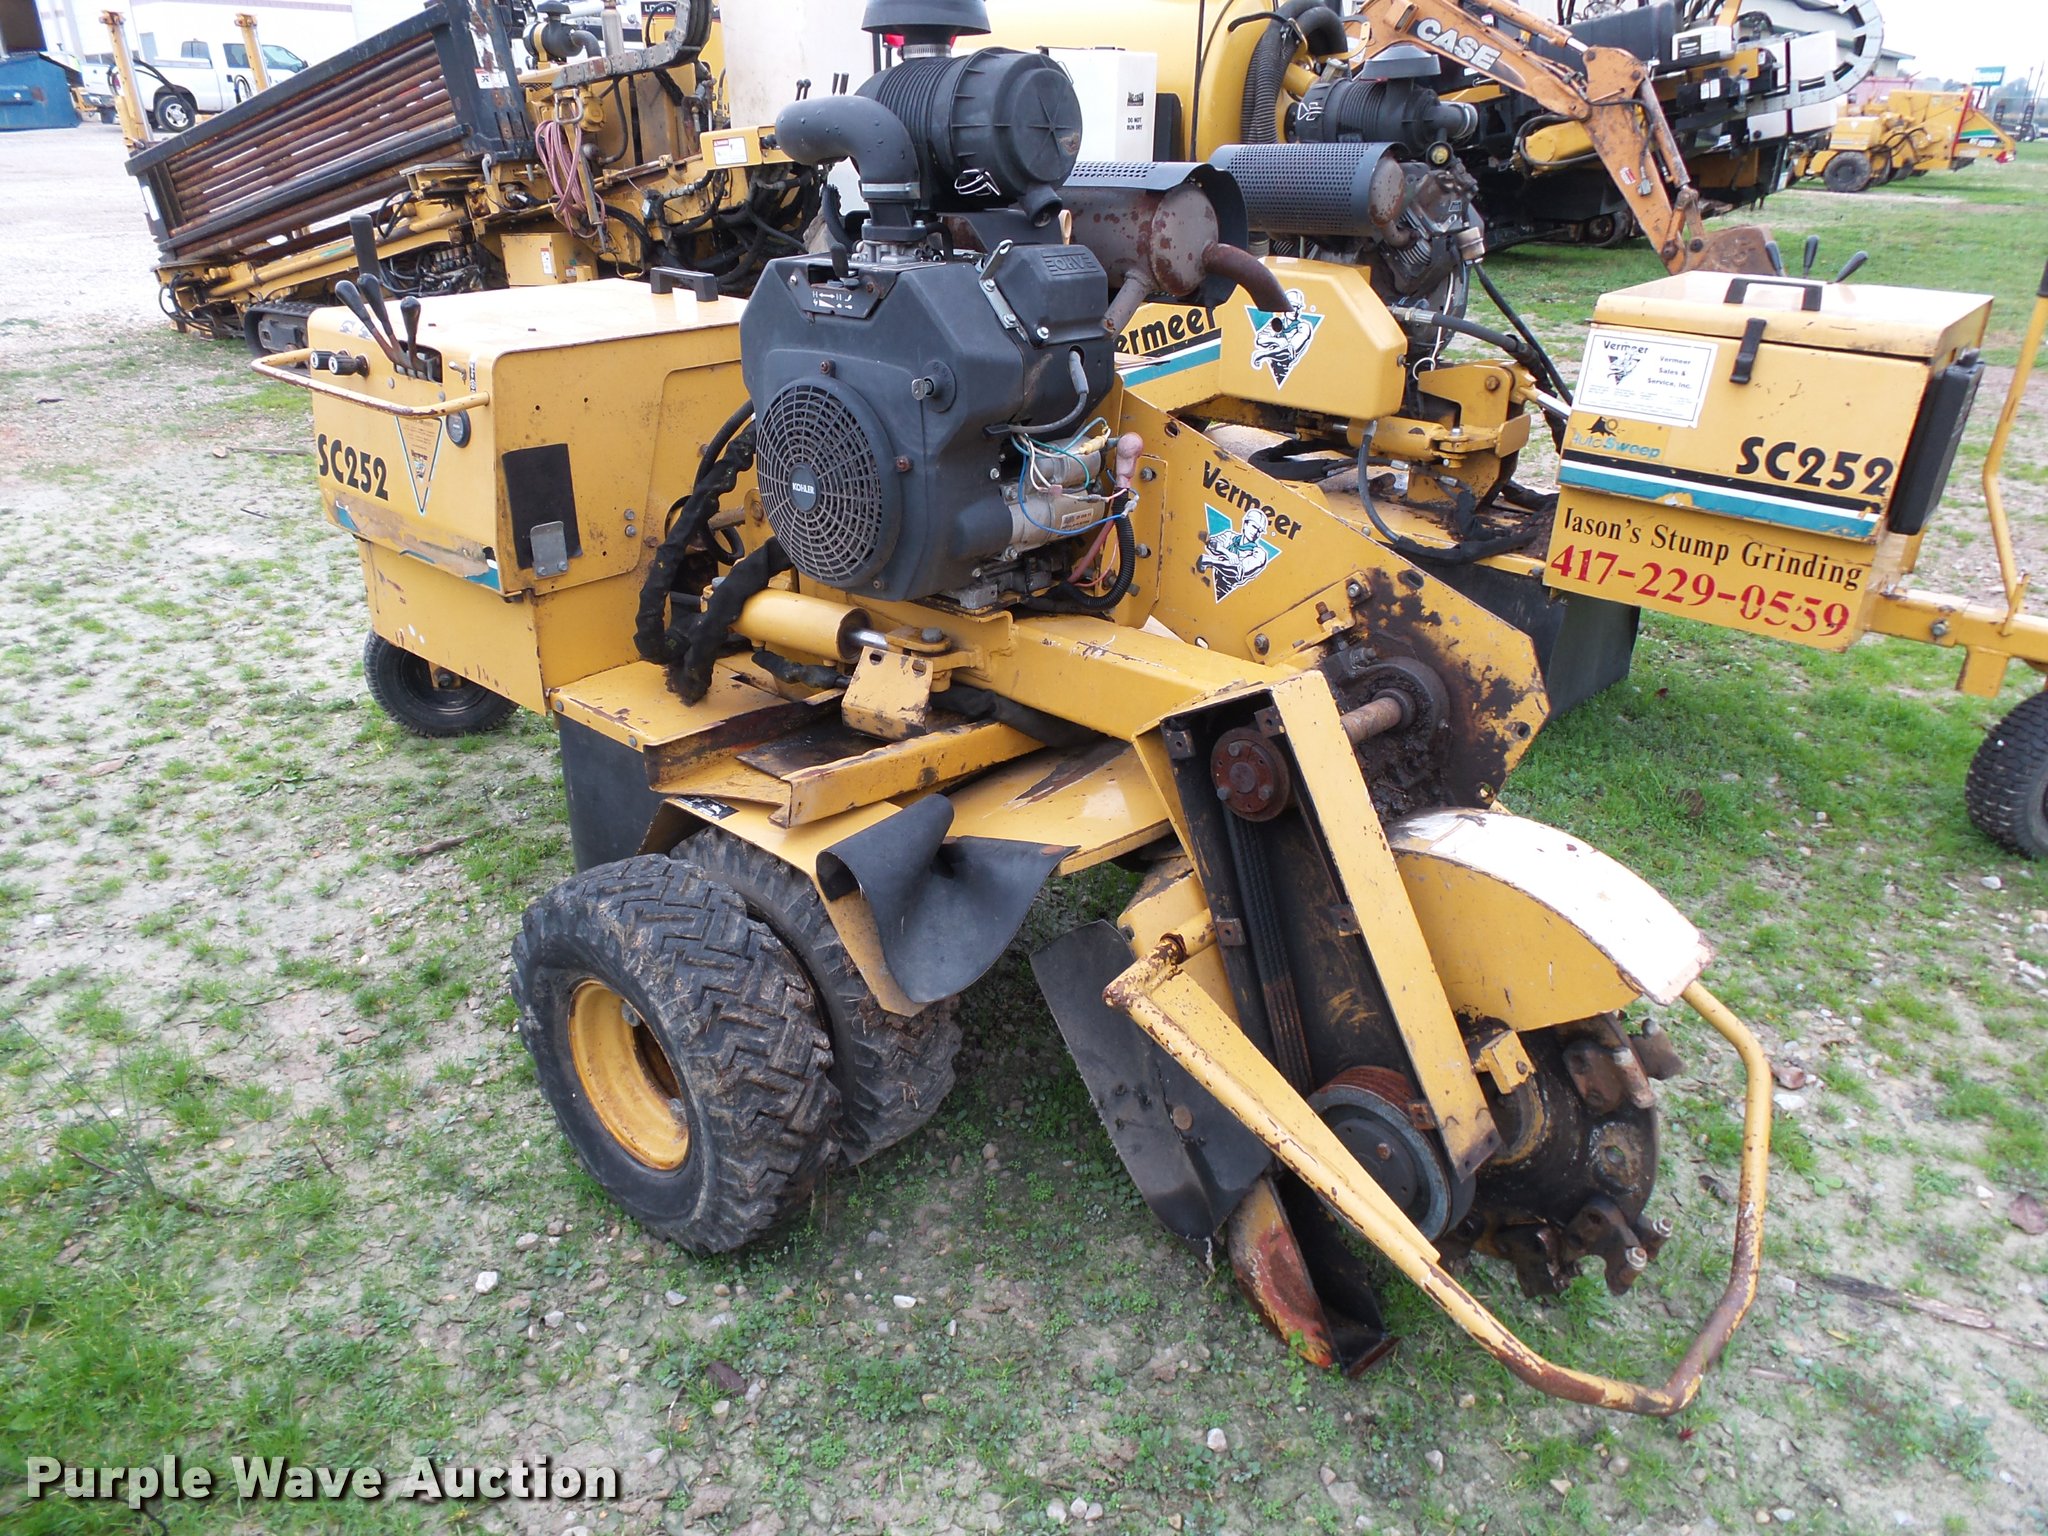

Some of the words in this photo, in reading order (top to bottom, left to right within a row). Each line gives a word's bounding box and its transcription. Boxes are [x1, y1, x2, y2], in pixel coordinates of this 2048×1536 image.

[1417, 18, 1501, 71] CASE
[1115, 308, 1216, 355] ermeer
[1603, 340, 1649, 354] Vermeer
[1659, 356, 1692, 365] Vermeer
[1659, 367, 1679, 376] Sales
[317, 433, 389, 502] SC252
[792, 482, 815, 495] KOHLER
[1735, 436, 1895, 497] SC252
[1202, 460, 1302, 541] Vermeer
[1650, 523, 1730, 566] Stump
[1740, 540, 1864, 591] Grinding
[1550, 544, 1850, 637] 417-229-0559
